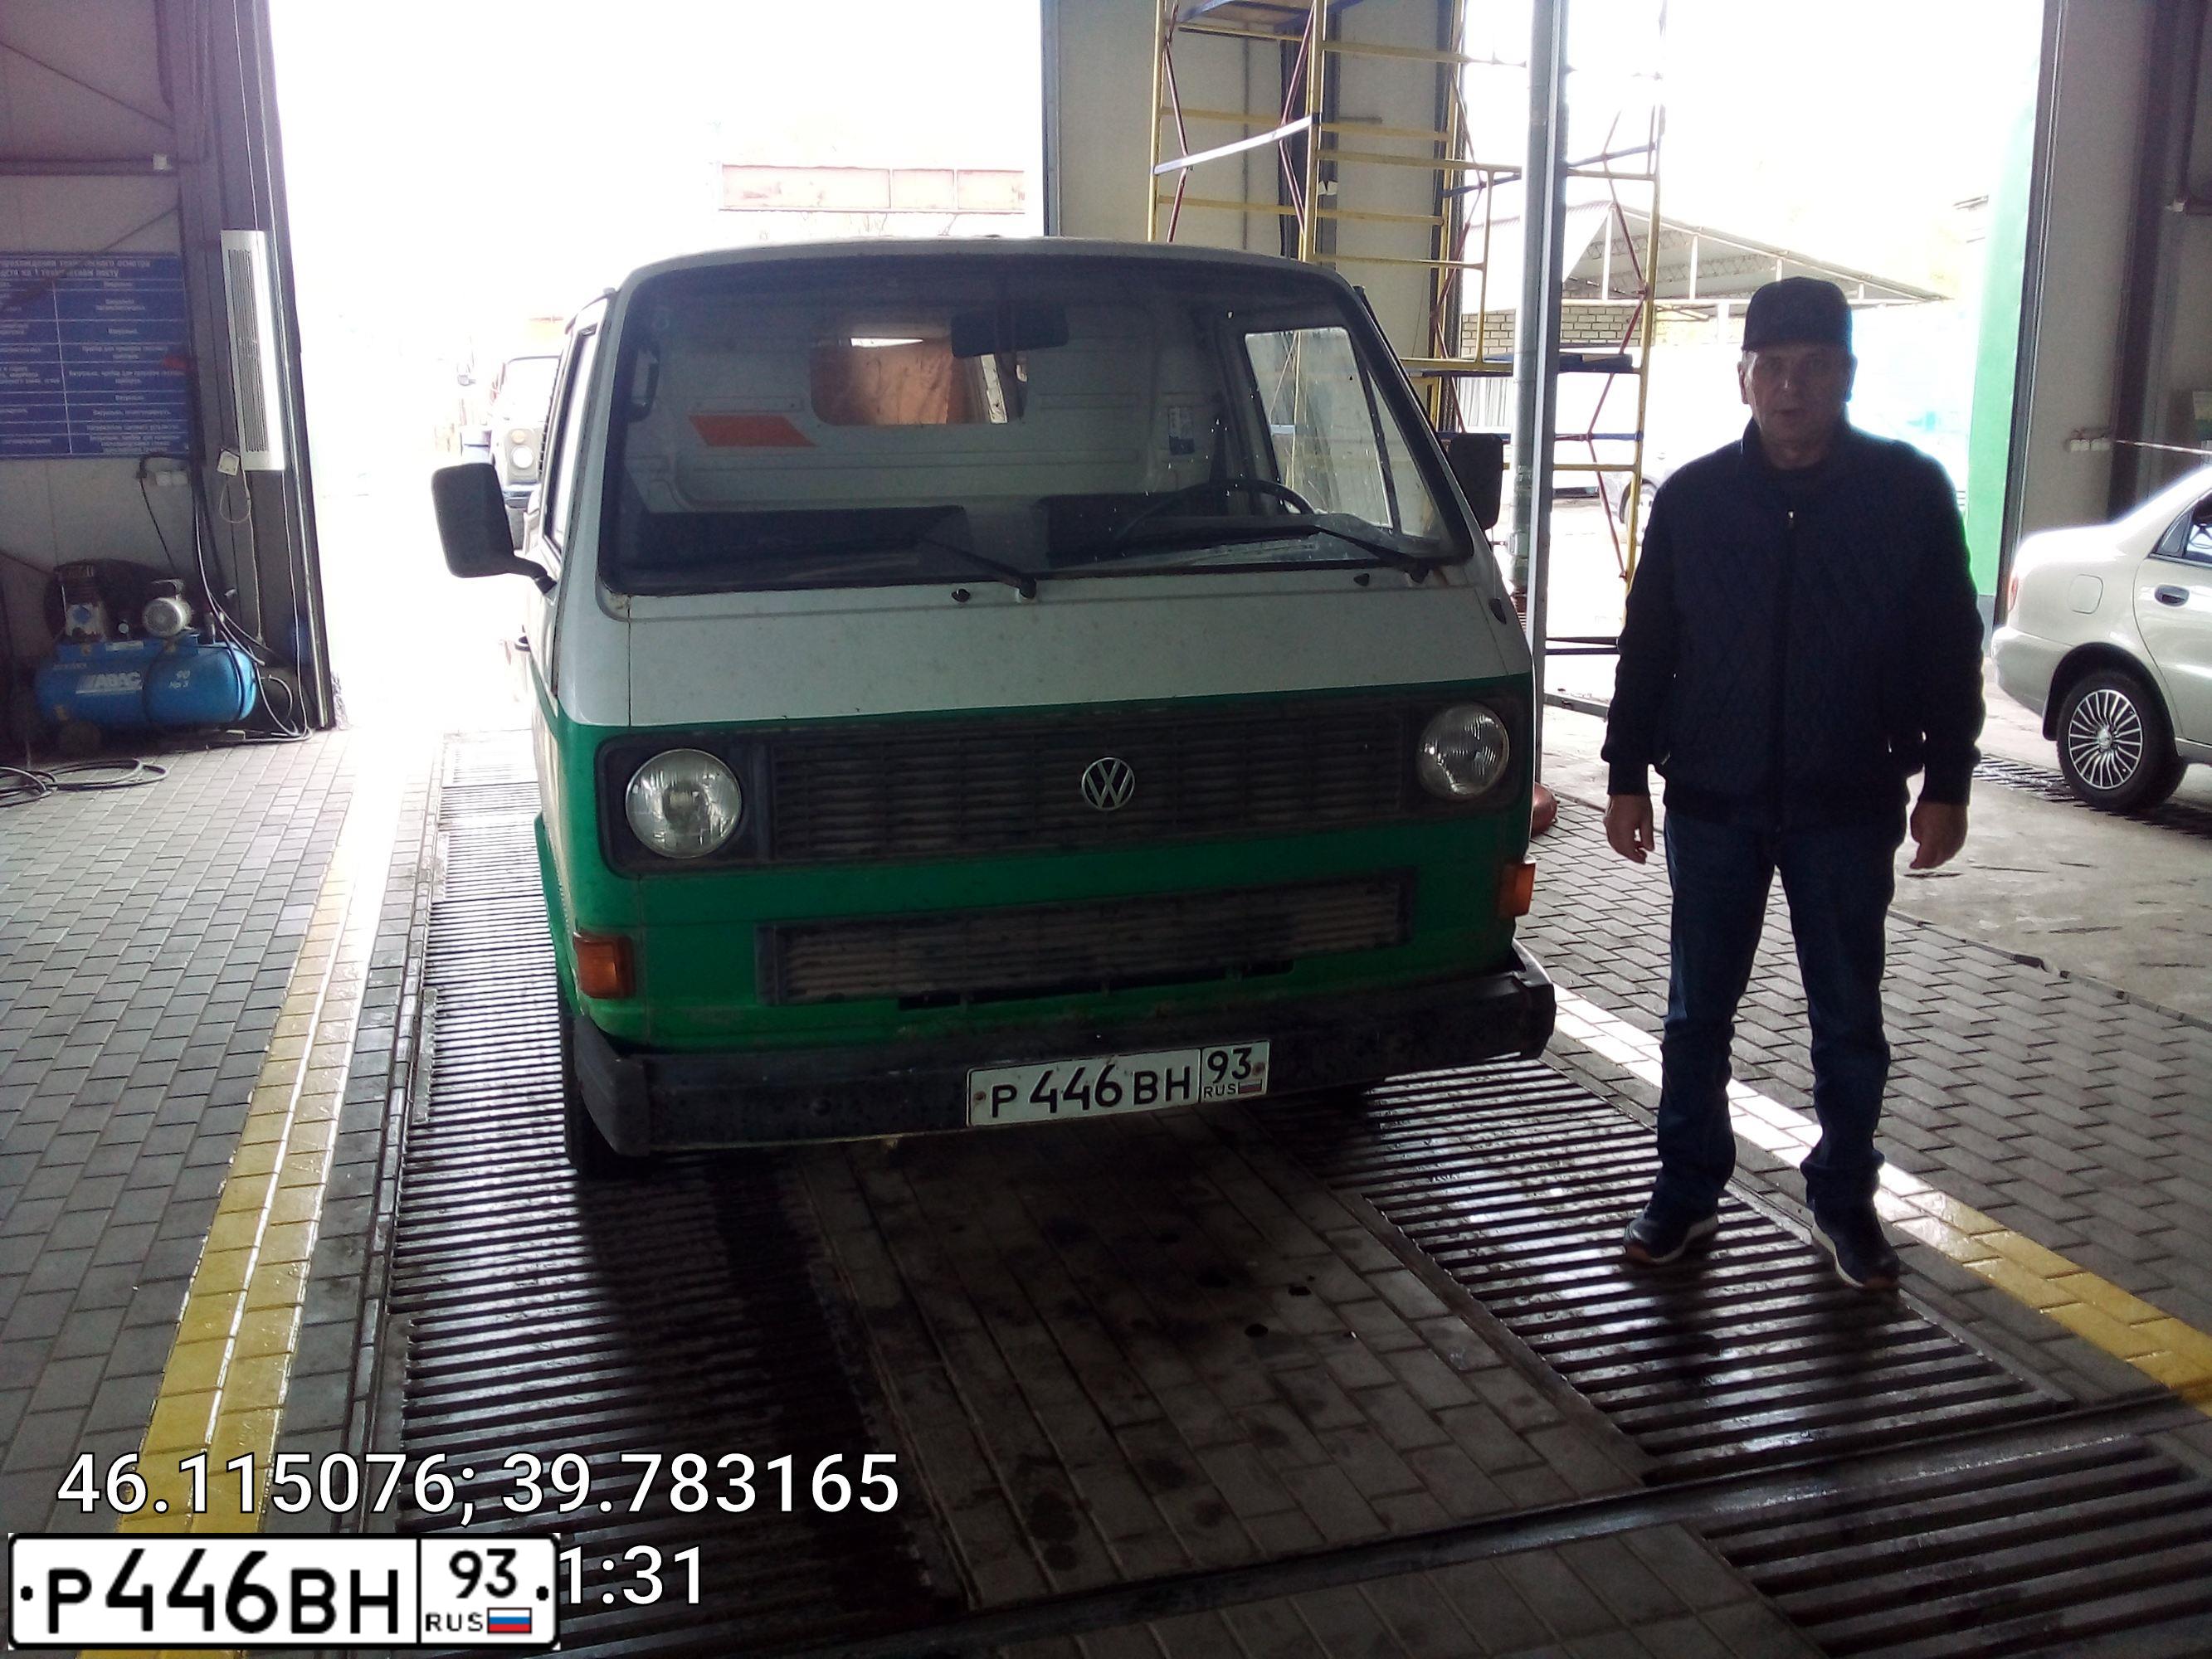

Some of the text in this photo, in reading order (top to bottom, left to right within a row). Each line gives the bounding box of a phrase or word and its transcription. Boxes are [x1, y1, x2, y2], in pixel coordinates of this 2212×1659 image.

[990, 1047, 1252, 1118] Р446ВН 93
[1203, 1086, 1236, 1099] RUS
